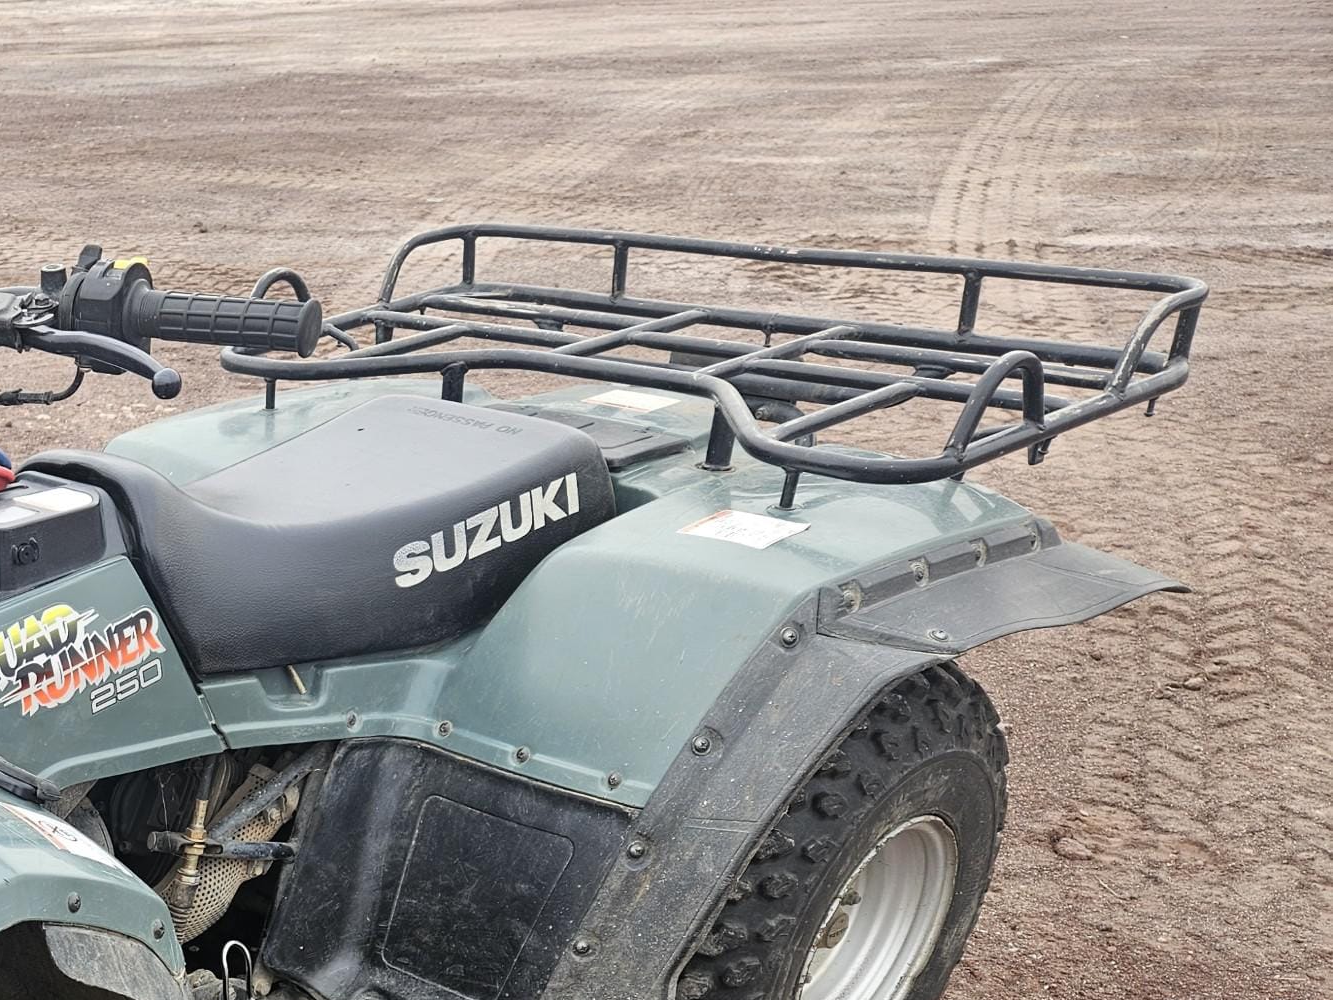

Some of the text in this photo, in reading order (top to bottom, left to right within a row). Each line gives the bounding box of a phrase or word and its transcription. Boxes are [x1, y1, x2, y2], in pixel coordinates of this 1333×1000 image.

[393, 472, 580, 588] SUZUKI
[12, 607, 166, 716] RUNNER
[91, 657, 163, 714] 250
